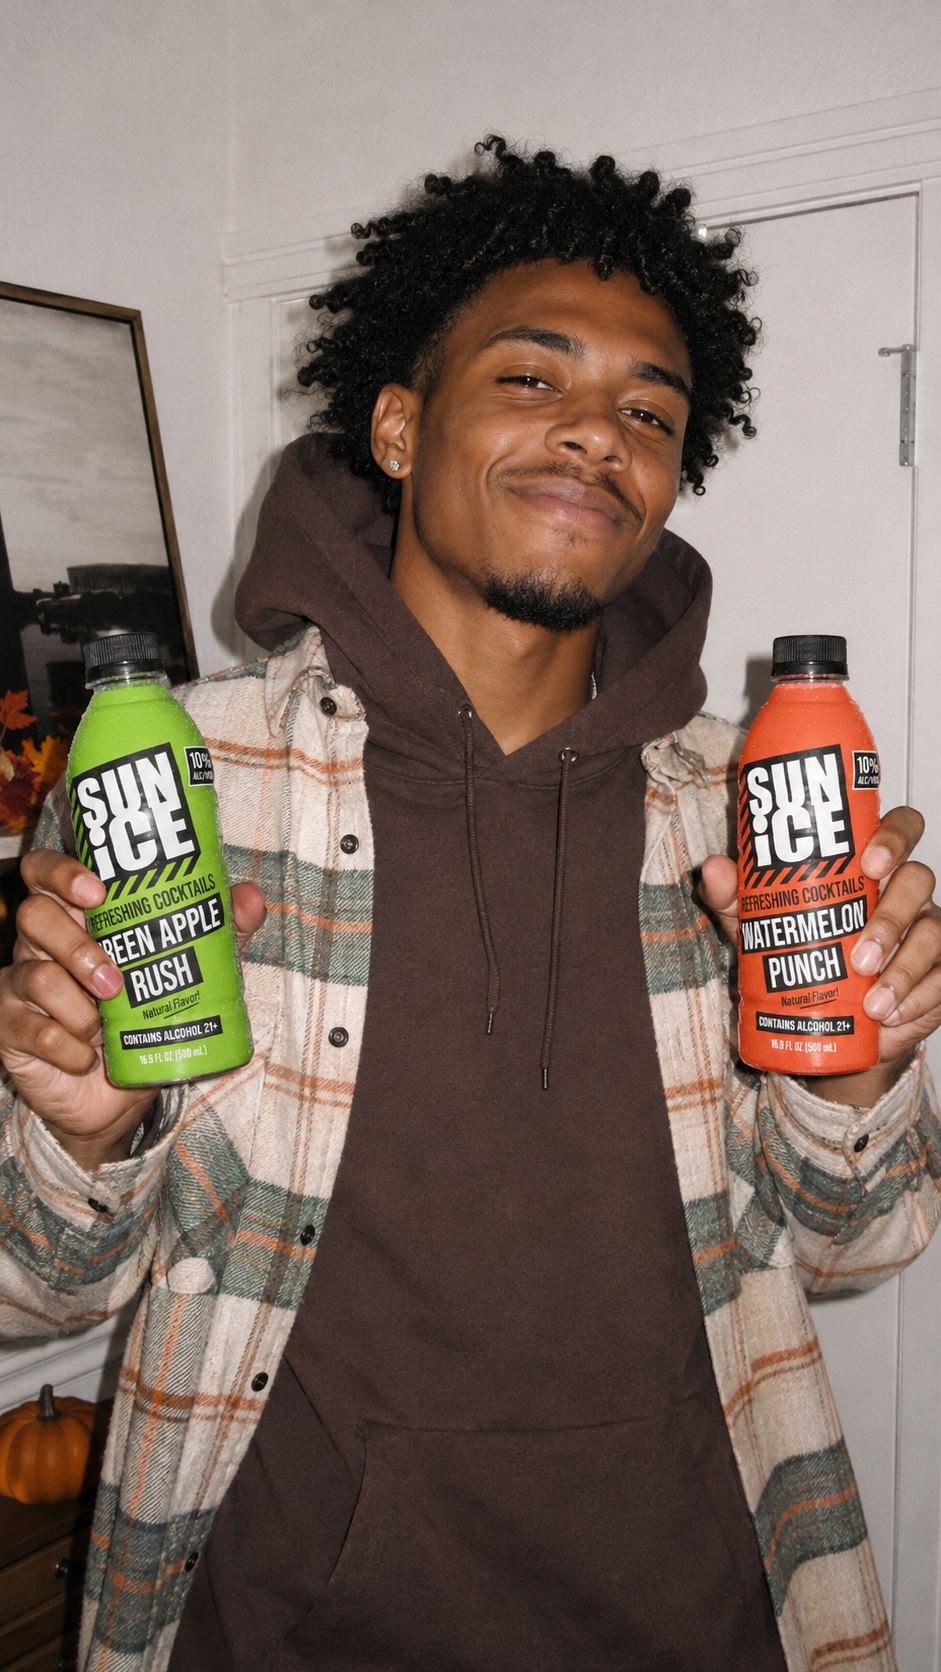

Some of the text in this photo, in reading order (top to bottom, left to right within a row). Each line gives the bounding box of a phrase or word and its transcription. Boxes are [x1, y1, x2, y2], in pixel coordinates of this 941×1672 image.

[189, 751, 212, 769] 10%
[857, 756, 879, 774] 10%
[77, 752, 182, 828] SUN
[747, 753, 843, 816] SUN
[153, 873, 216, 910] COCKTAILS
[802, 876, 865, 904] COCKTAILS
[98, 898, 221, 966] REEN APPLE
[742, 900, 865, 950] WATERMELON
[130, 953, 194, 1002] RUSH
[768, 947, 841, 989] PUNCH
[142, 990, 200, 1020] Natural Flavor!
[781, 987, 839, 1007] Natural Flavor!
[123, 1021, 218, 1045] CONTAINS ALCOHOL 21+
[759, 1016, 851, 1032] CONTAINS ALCOHOL 21+
[155, 1053, 163, 1063] FL
[164, 1051, 173, 1061] OZ
[175, 1048, 192, 1060] (500
[785, 1041, 793, 1051] FL
[794, 1041, 803, 1051] OZ
[805, 1042, 822, 1053] (500
